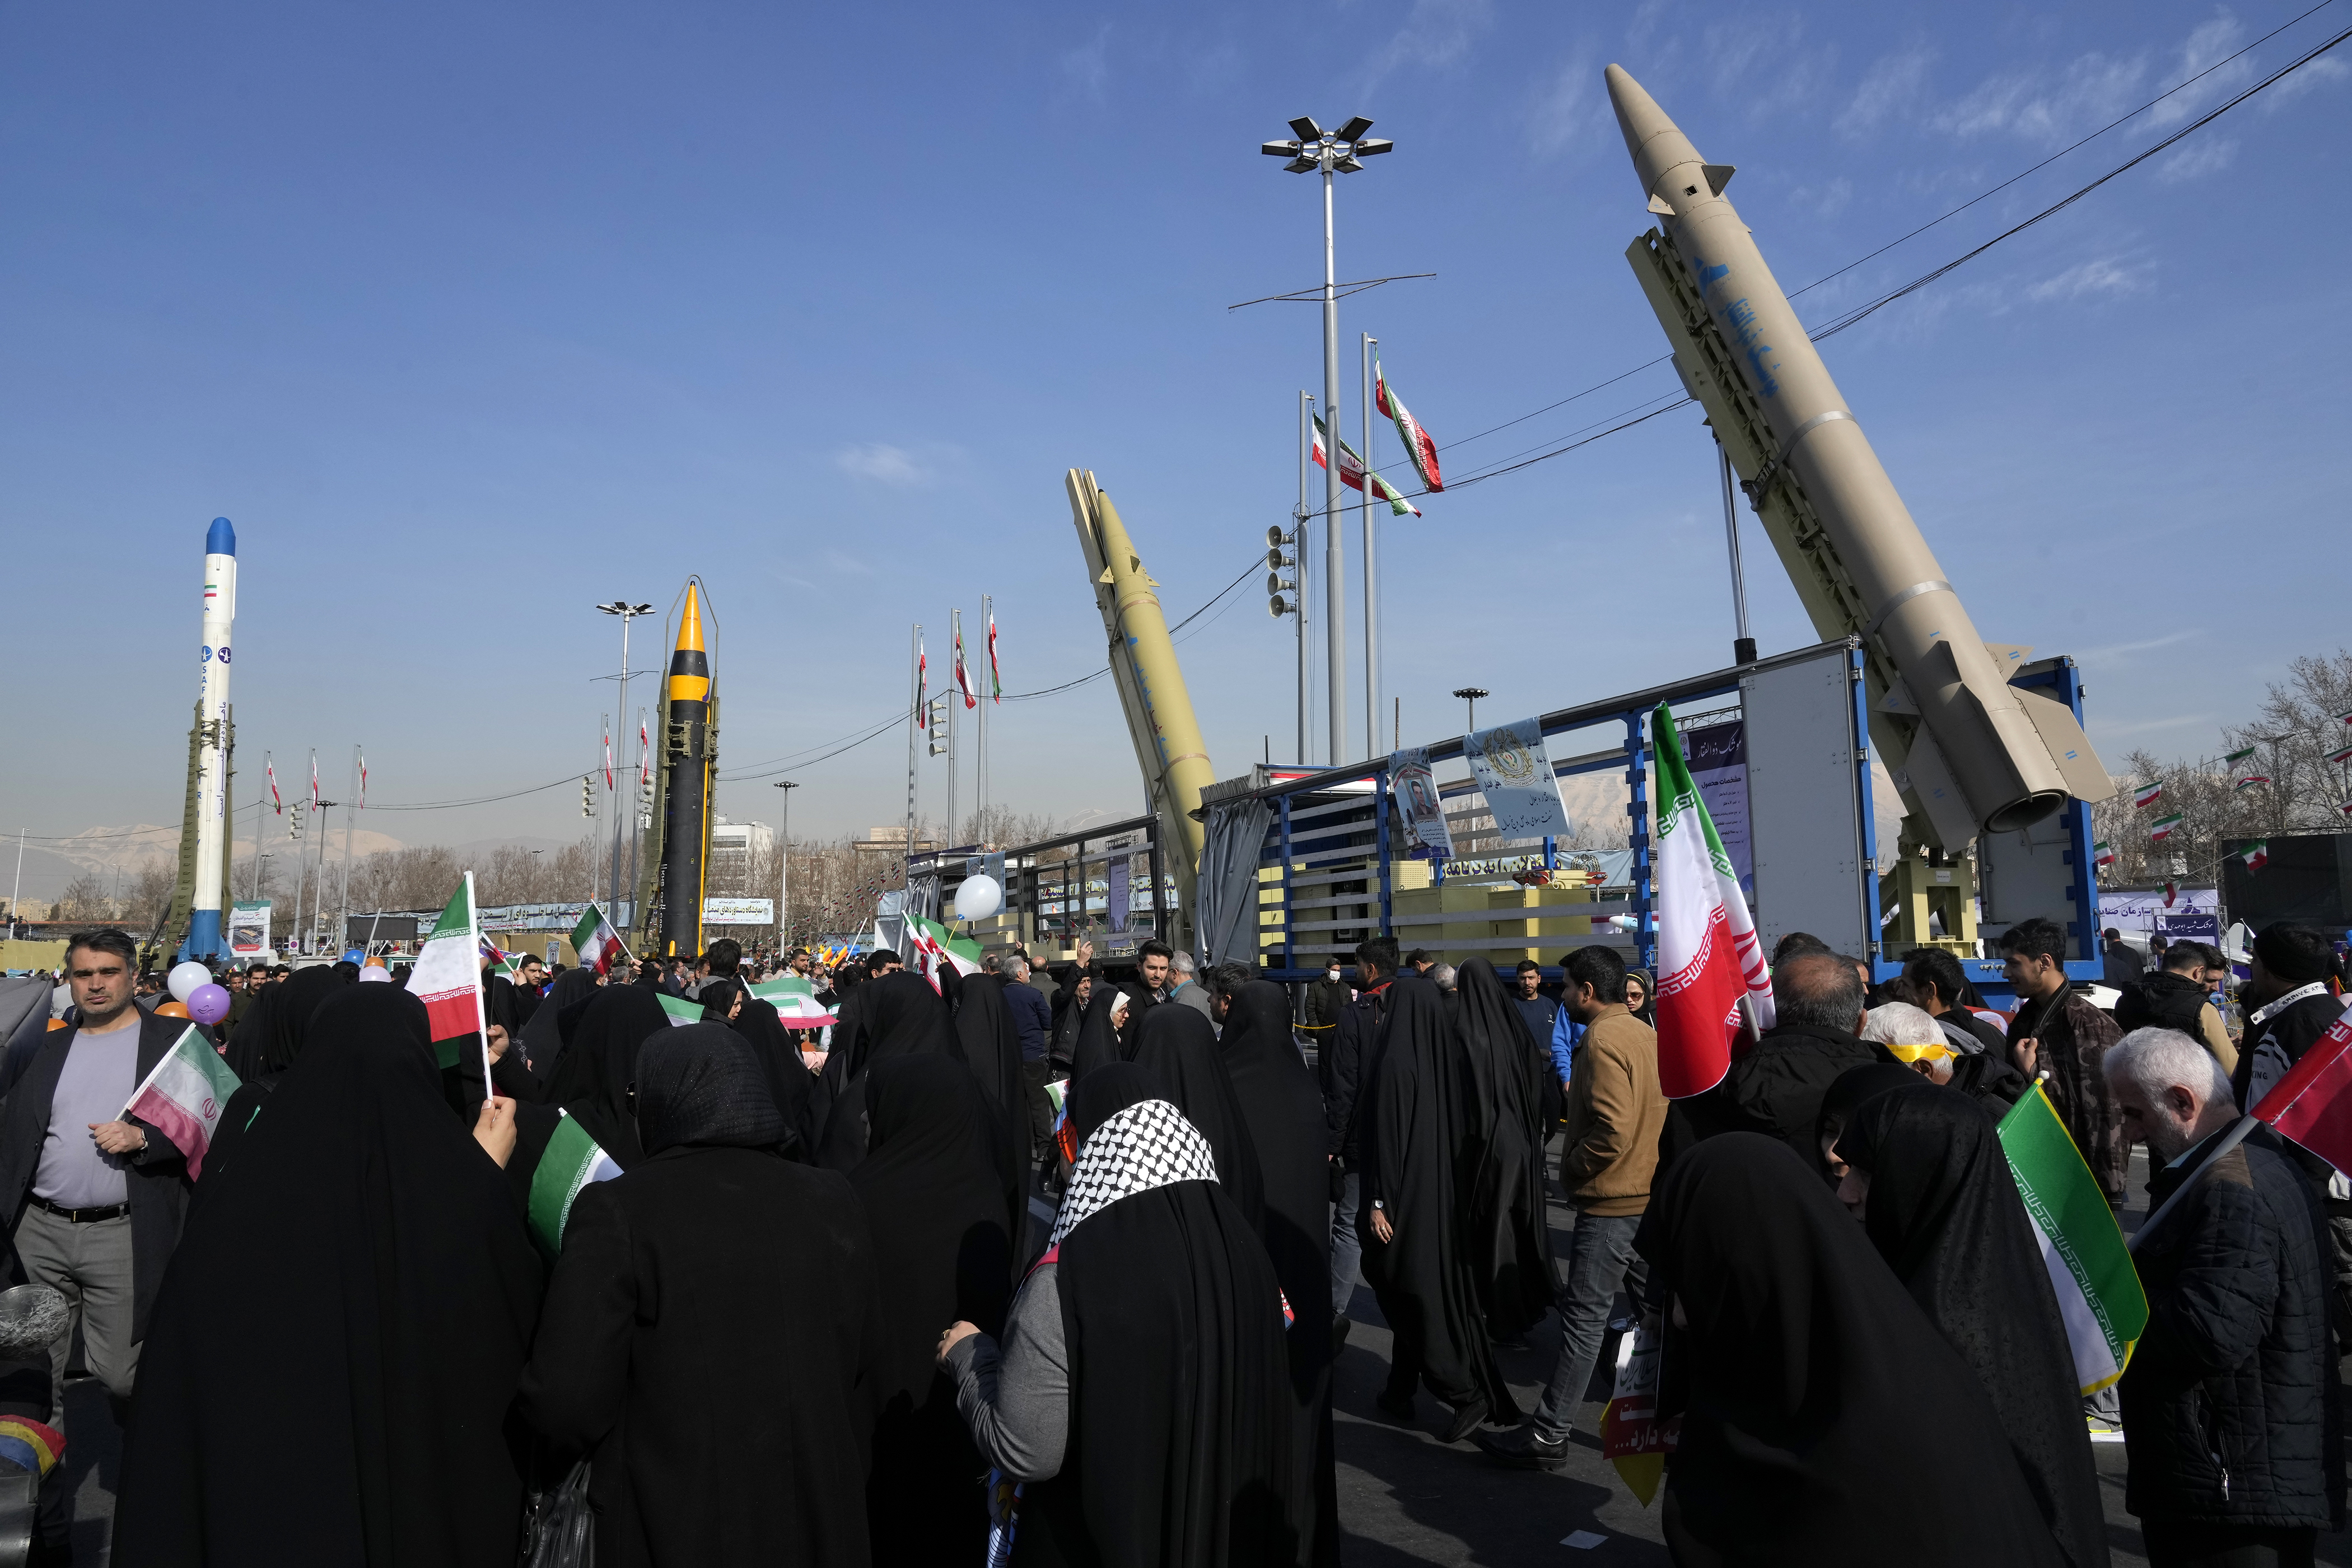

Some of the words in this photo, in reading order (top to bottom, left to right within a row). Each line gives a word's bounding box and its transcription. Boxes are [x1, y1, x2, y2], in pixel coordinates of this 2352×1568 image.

[1719, 728, 1742, 754] موشک
[1697, 742, 1718, 758] ذوالفقار
[1719, 776, 1742, 785] مشخصات
[1510, 855, 1562, 872] مئولان
[720, 906, 745, 916] دستاوردهای
[745, 905, 763, 916] نمایشگاه
[2121, 907, 2151, 917] سازمان
[2186, 920, 2197, 932] شهید
[2195, 919, 2213, 929] موشک
[2282, 989, 2309, 1005] ARRIVE
[1615, 1423, 1658, 1452] دارد...
